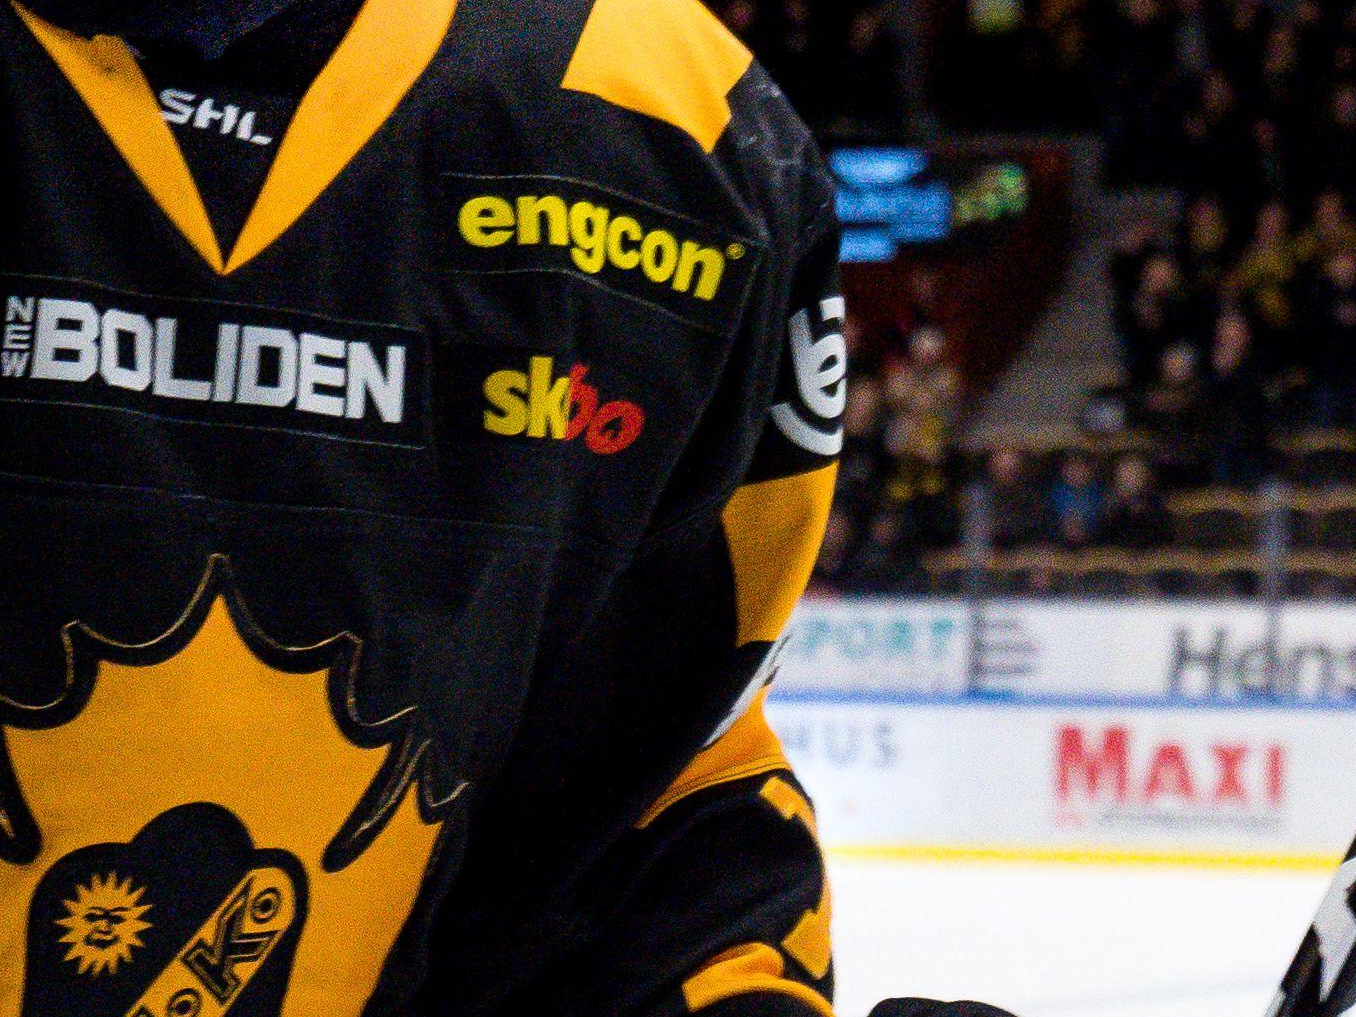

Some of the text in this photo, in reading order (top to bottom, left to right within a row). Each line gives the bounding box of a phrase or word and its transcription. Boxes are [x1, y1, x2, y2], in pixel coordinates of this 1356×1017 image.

[158, 87, 273, 146] SHL
[458, 194, 726, 301] engcon
[0, 295, 406, 424] NEW BOLIDEN
